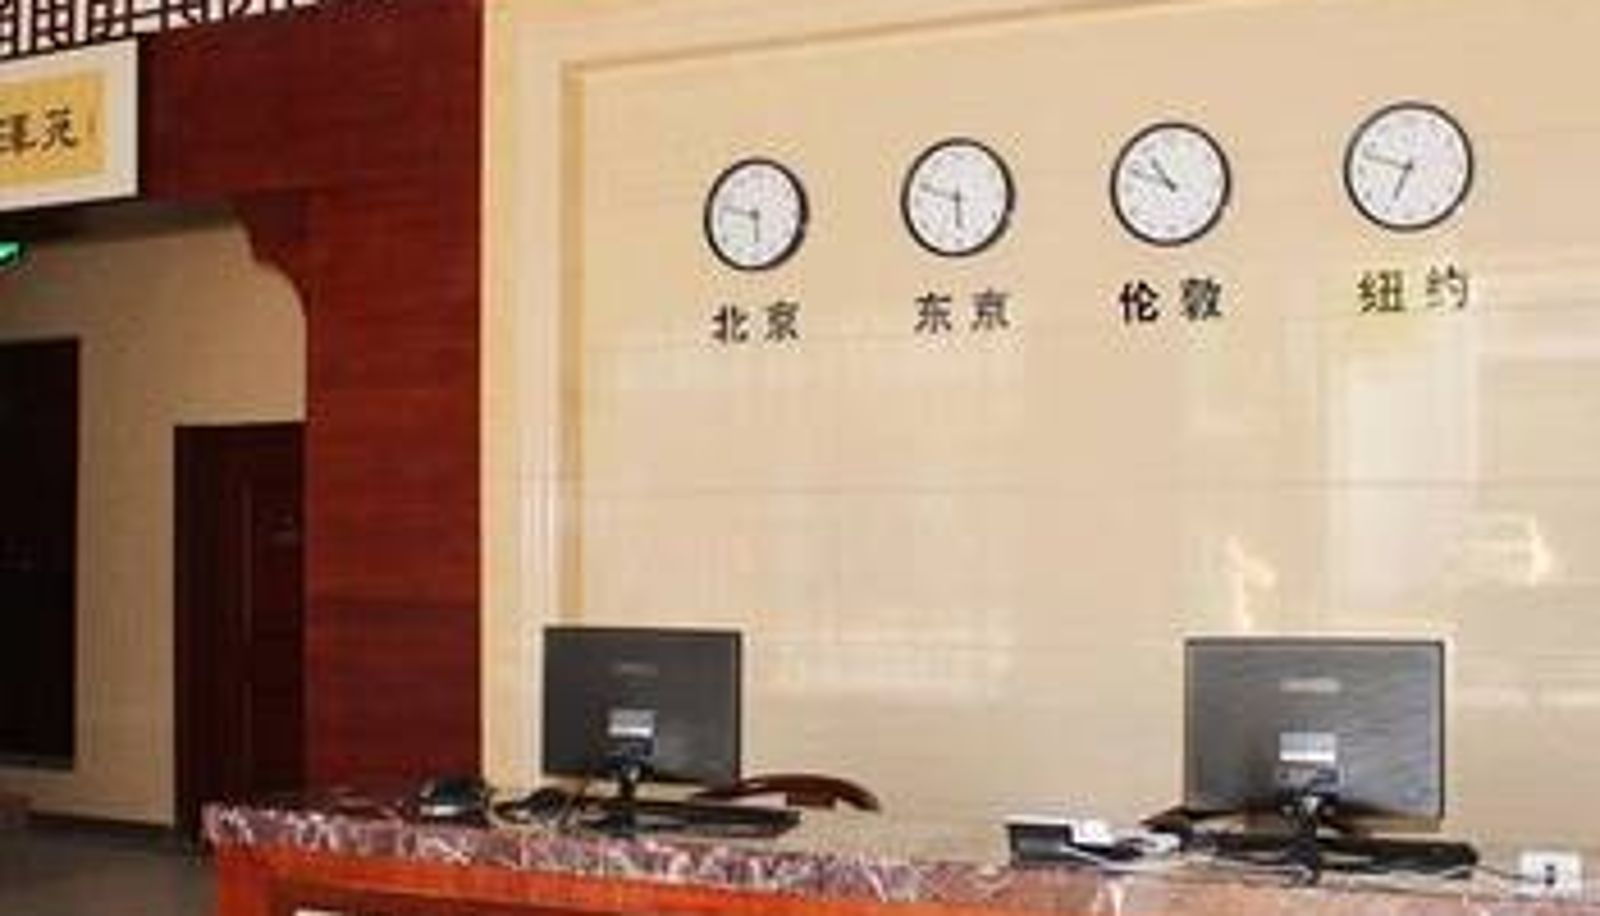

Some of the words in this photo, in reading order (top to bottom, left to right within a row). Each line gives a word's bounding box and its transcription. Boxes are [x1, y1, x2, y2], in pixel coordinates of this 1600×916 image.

[913, 286, 1012, 335] 东京
[1118, 277, 1223, 325] 伦敦
[1356, 263, 1470, 315] 纽约
[711, 301, 800, 345] 北京
